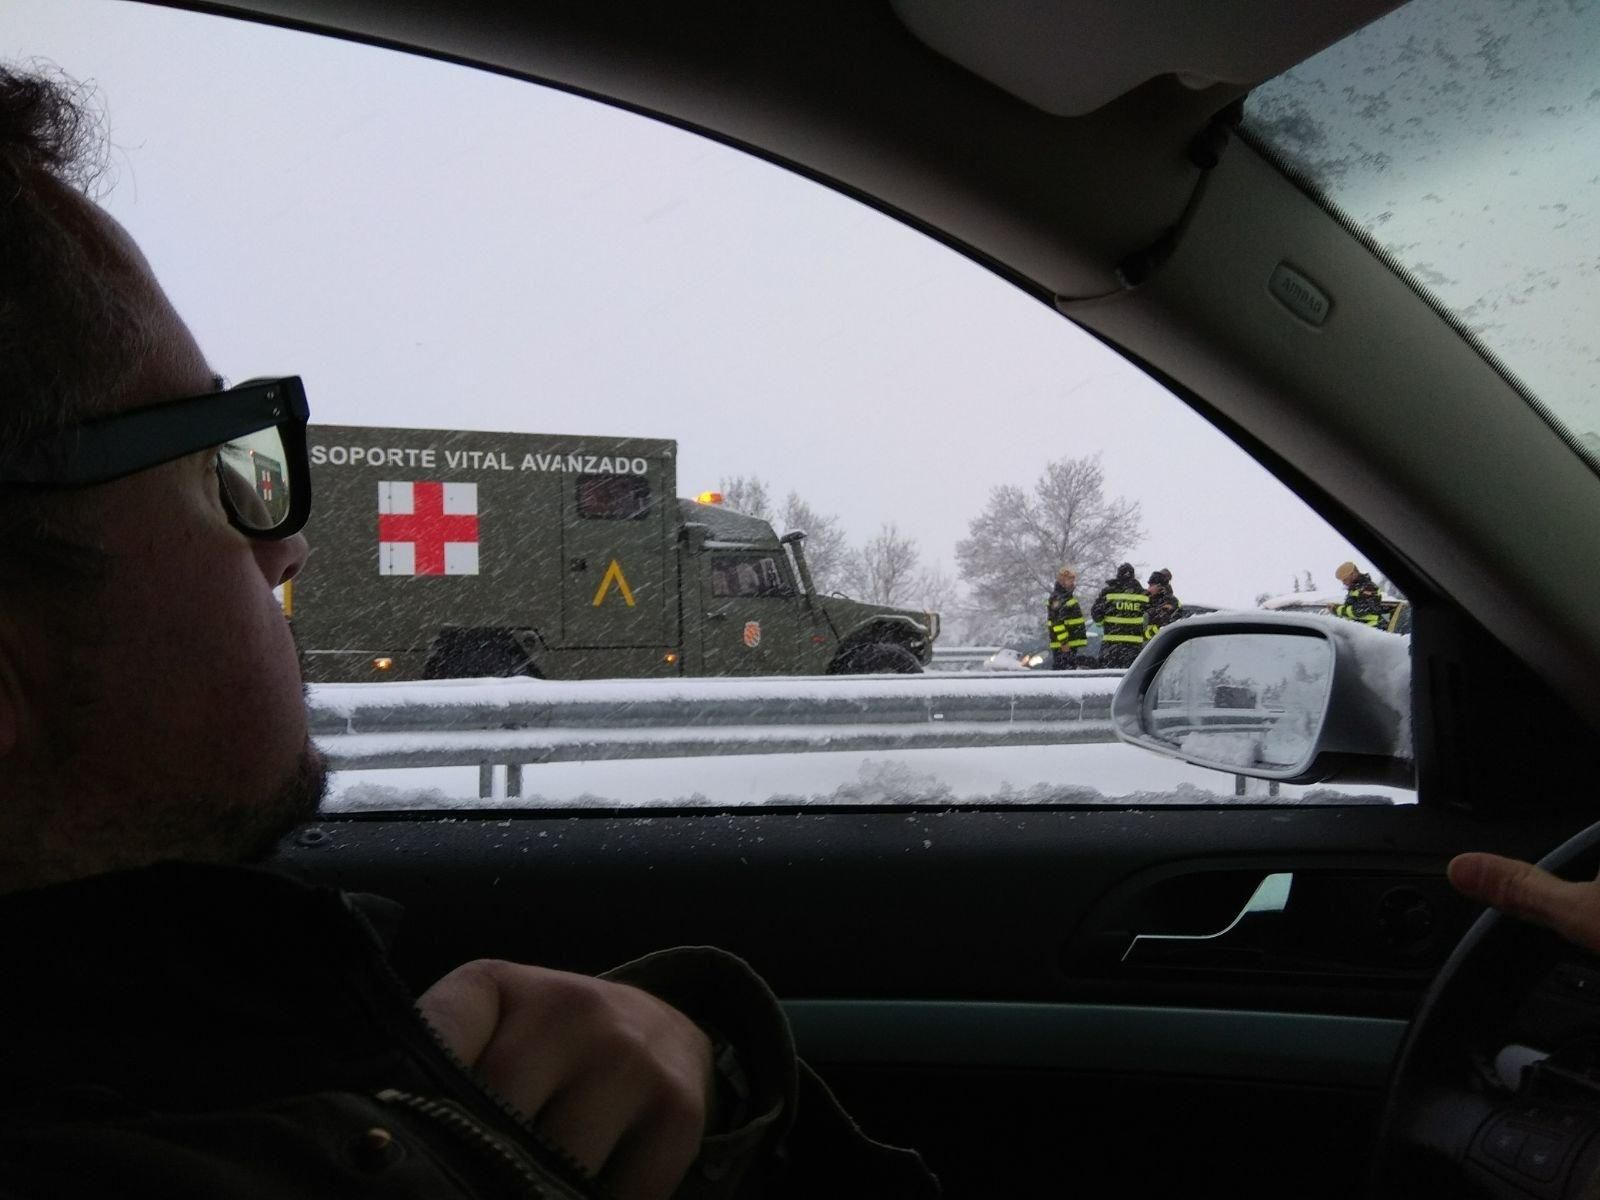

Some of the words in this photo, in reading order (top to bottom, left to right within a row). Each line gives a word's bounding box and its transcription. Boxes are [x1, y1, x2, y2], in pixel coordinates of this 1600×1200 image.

[310, 445, 437, 468] SOPORTE
[445, 450, 514, 471] VITAL
[520, 453, 649, 475] AVANZADO
[1115, 601, 1142, 612] UME
